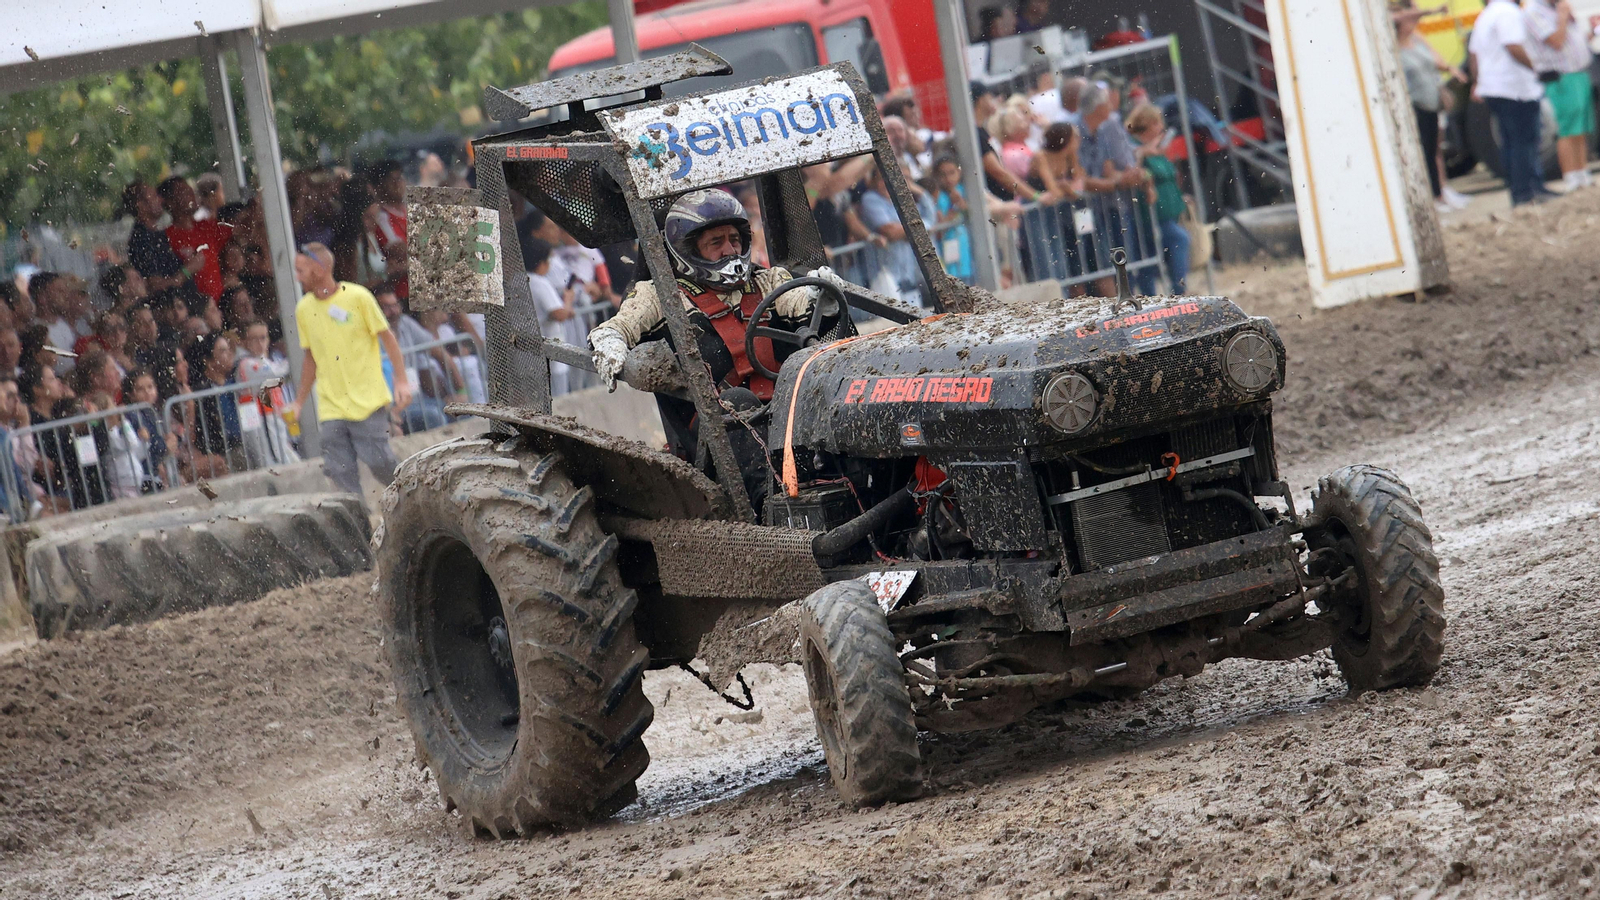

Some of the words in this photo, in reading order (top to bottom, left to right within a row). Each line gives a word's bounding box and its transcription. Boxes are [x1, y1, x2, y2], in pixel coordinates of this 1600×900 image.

[506, 146, 518, 158] EL
[844, 378, 868, 404] EL
[869, 378, 924, 403] RAYO
[922, 377, 994, 403] NEGRO
